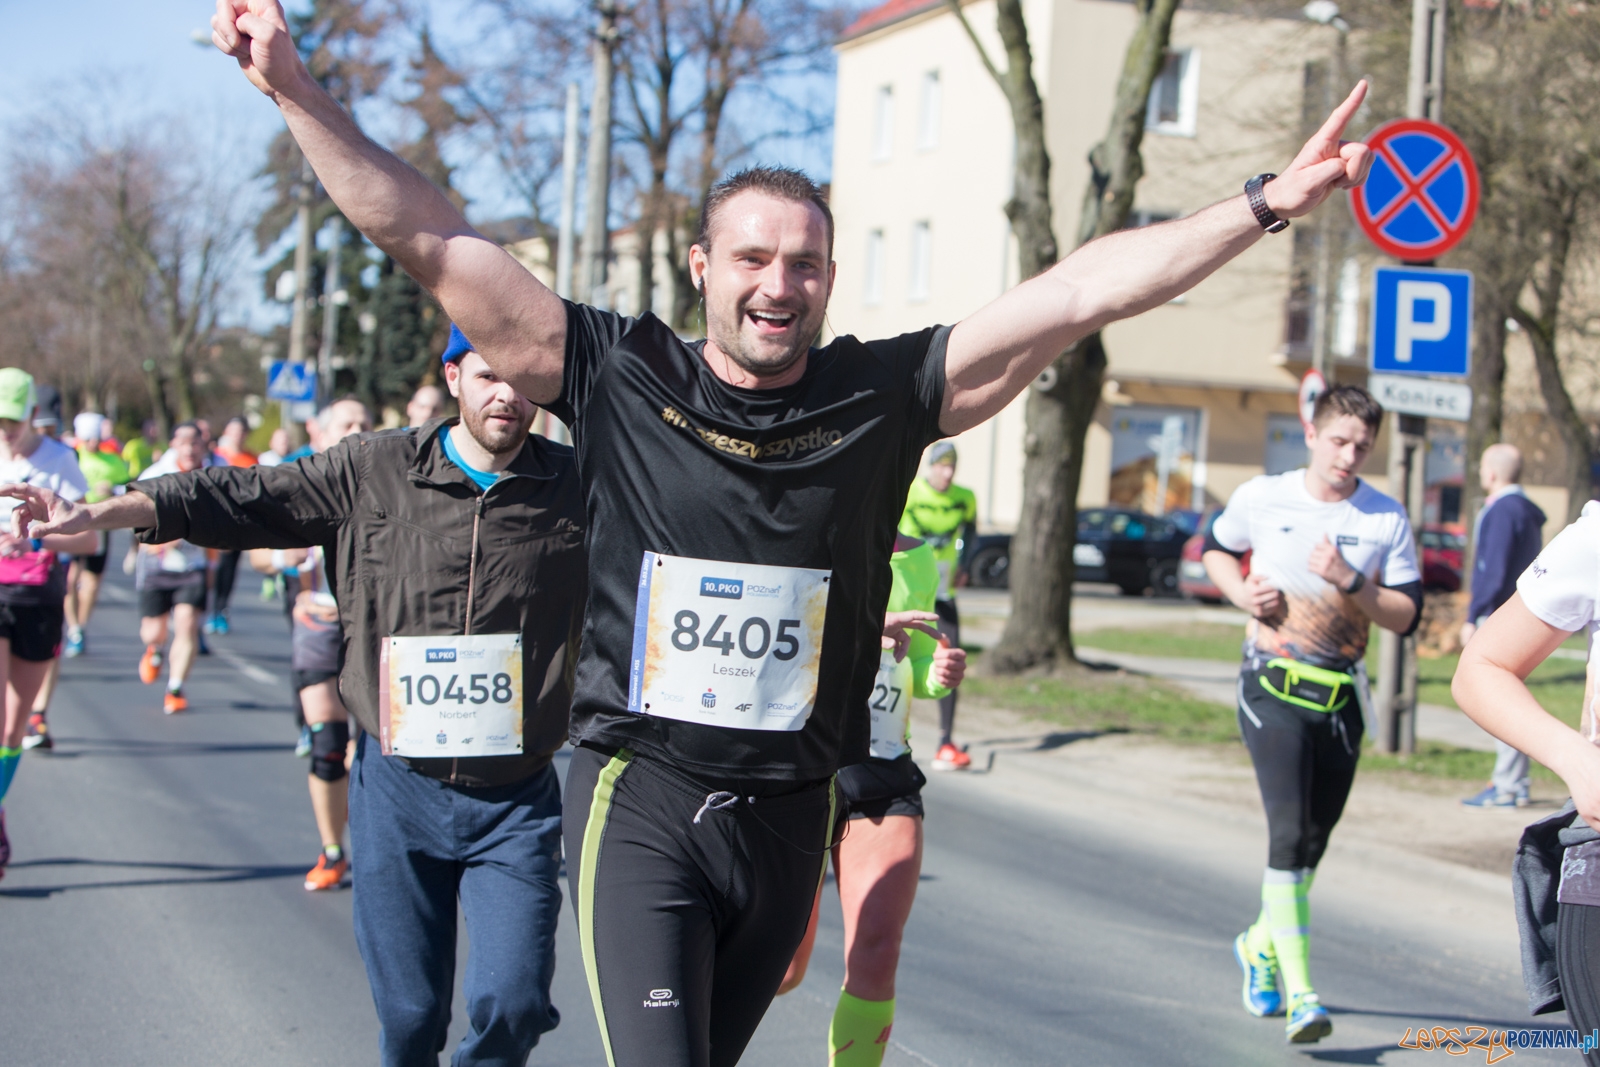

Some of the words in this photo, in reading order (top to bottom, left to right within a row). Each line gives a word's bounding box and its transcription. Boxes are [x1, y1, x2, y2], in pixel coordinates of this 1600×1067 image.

[1395, 280, 1452, 363] P
[1384, 381, 1458, 411] Koniec
[704, 582, 717, 593] 10.
[718, 583, 741, 595] PKO
[671, 609, 801, 661] 8405
[439, 651, 455, 660] PKO
[712, 663, 757, 678] Leszek
[399, 672, 513, 705] 10458
[872, 683, 902, 714] 27
[439, 711, 477, 719] Norbert
